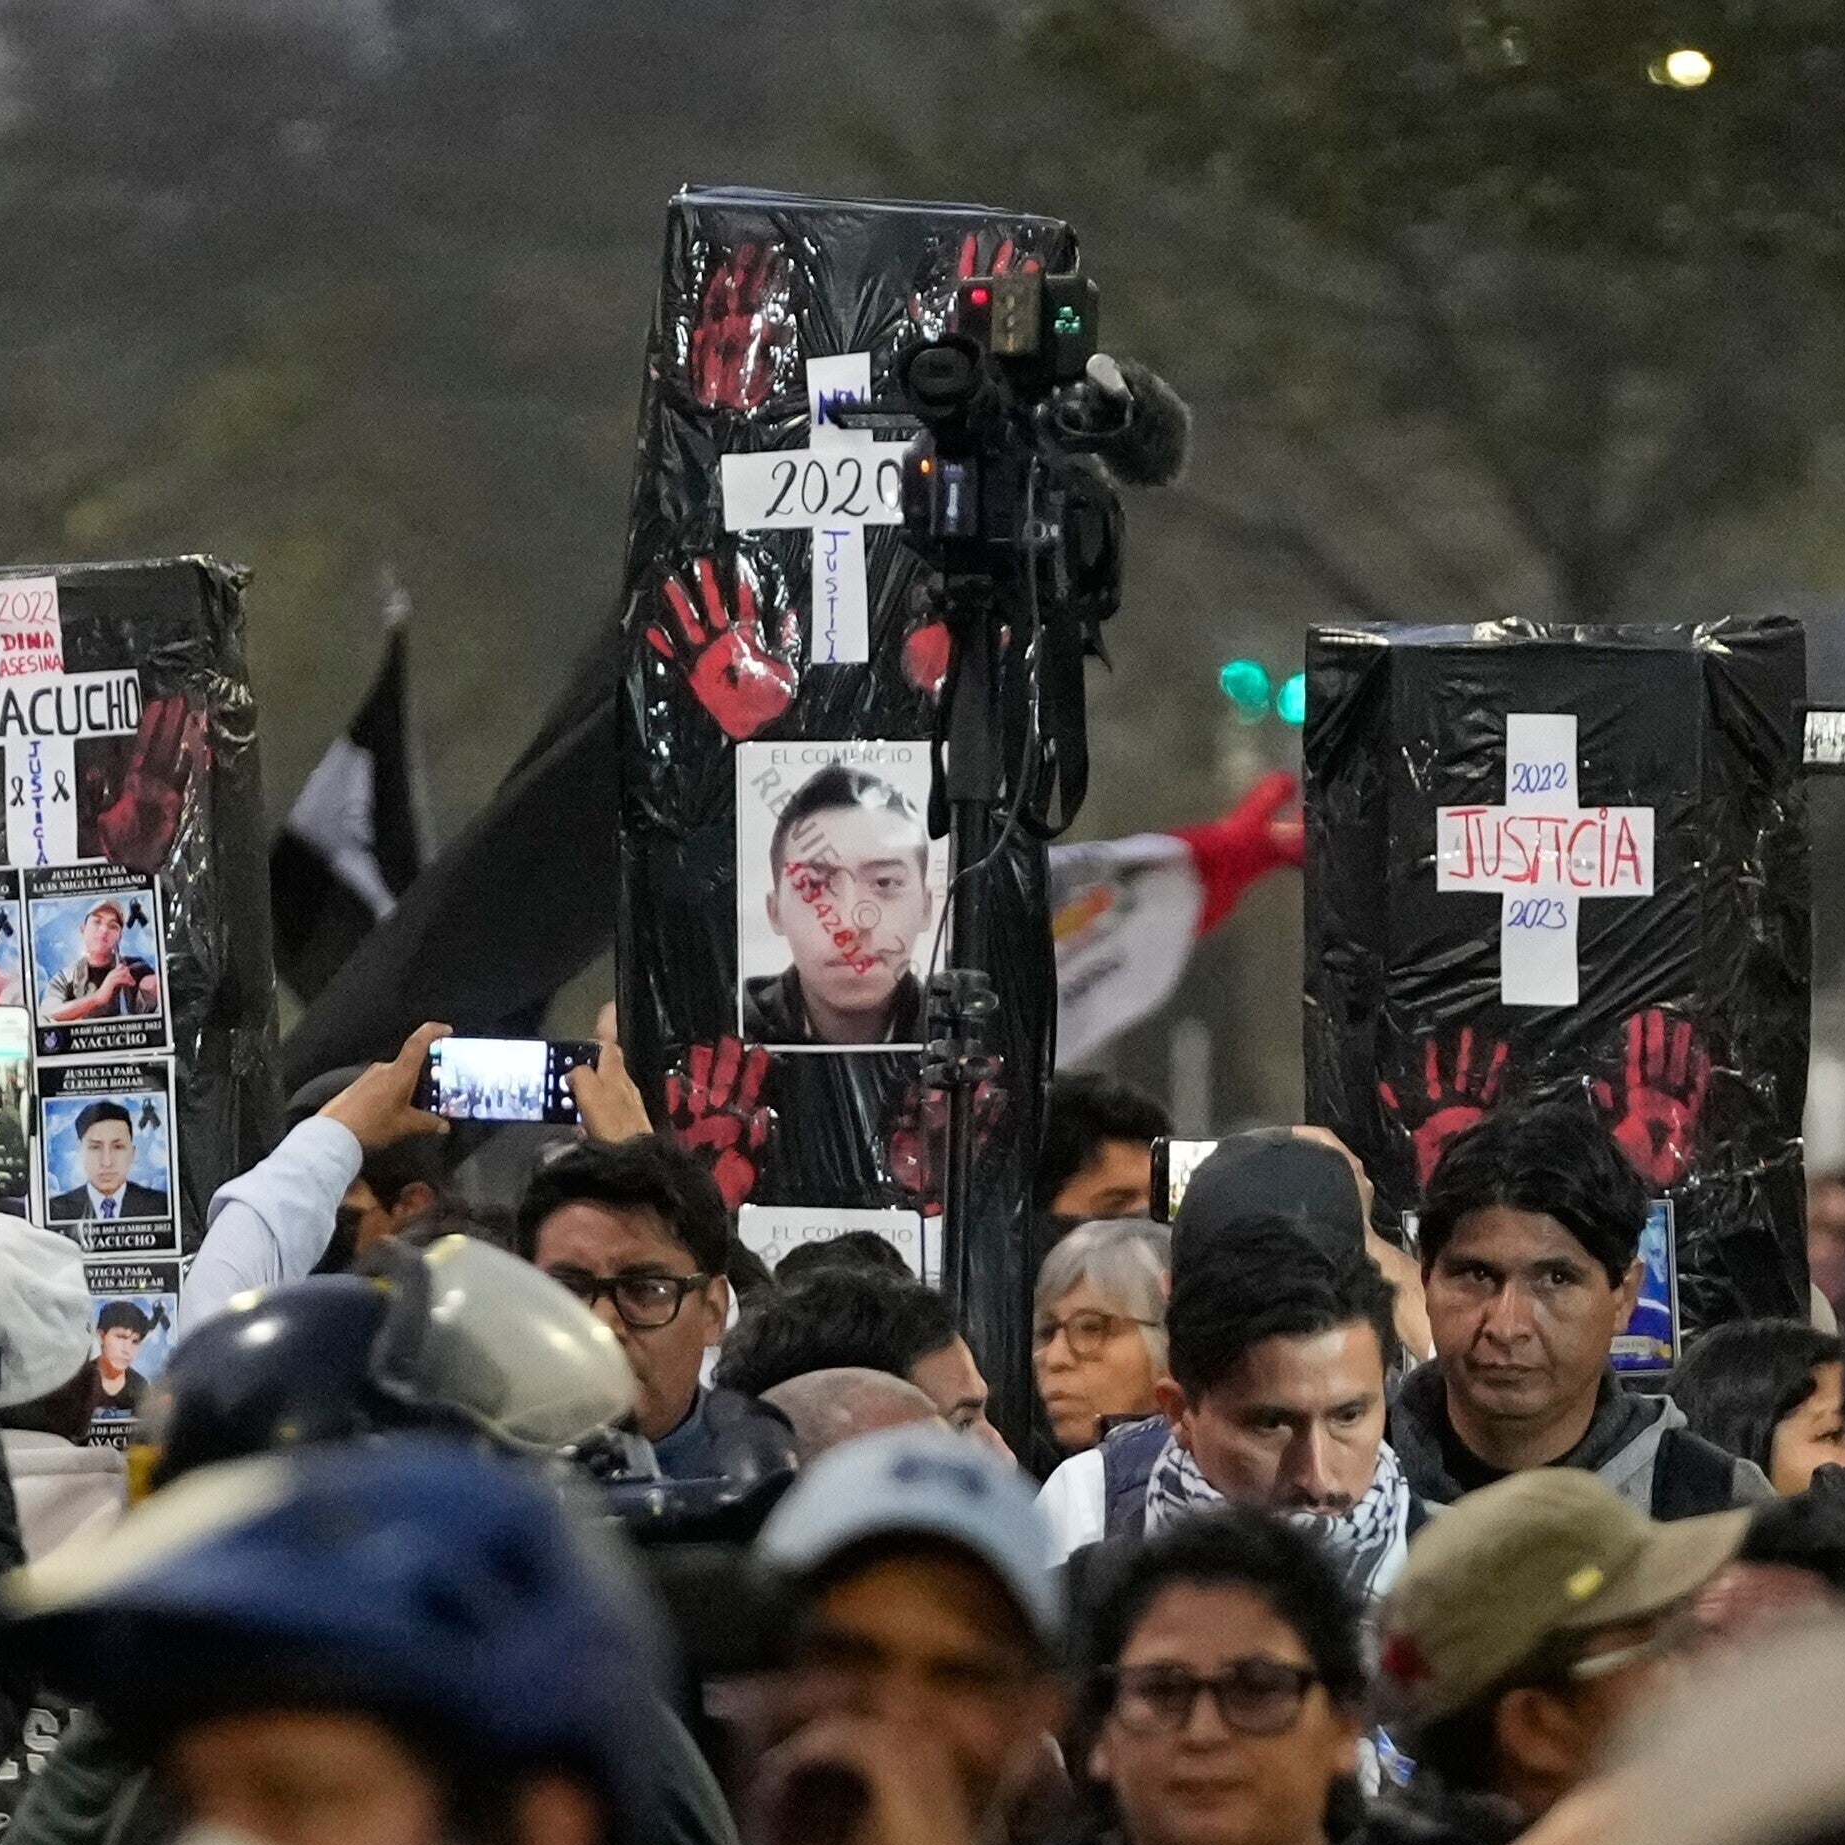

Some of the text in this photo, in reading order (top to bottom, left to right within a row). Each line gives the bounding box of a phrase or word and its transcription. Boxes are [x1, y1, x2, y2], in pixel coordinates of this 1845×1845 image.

[764, 458, 901, 518] 2020
[0, 630, 55, 651] DINA
[0, 654, 65, 677] ASESINA
[771, 747, 913, 765] EL COMERCIO
[1511, 762, 1568, 794] 2022
[28, 740, 48, 866] JUSTICIA
[1446, 806, 1643, 888] JUSTICIA
[51, 864, 127, 880] JUSTICIA PARA
[33, 881, 57, 892] LUIS
[59, 878, 102, 890] MIGUEL
[102, 873, 147, 886] URBANO
[1507, 898, 1568, 930] 2023
[70, 1032, 147, 1050] AYACUCHO
[64, 1065, 142, 1079] JUSTICIA PARA
[771, 1226, 794, 1240] EL
[87, 1266, 152, 1278] STICIA PARA
